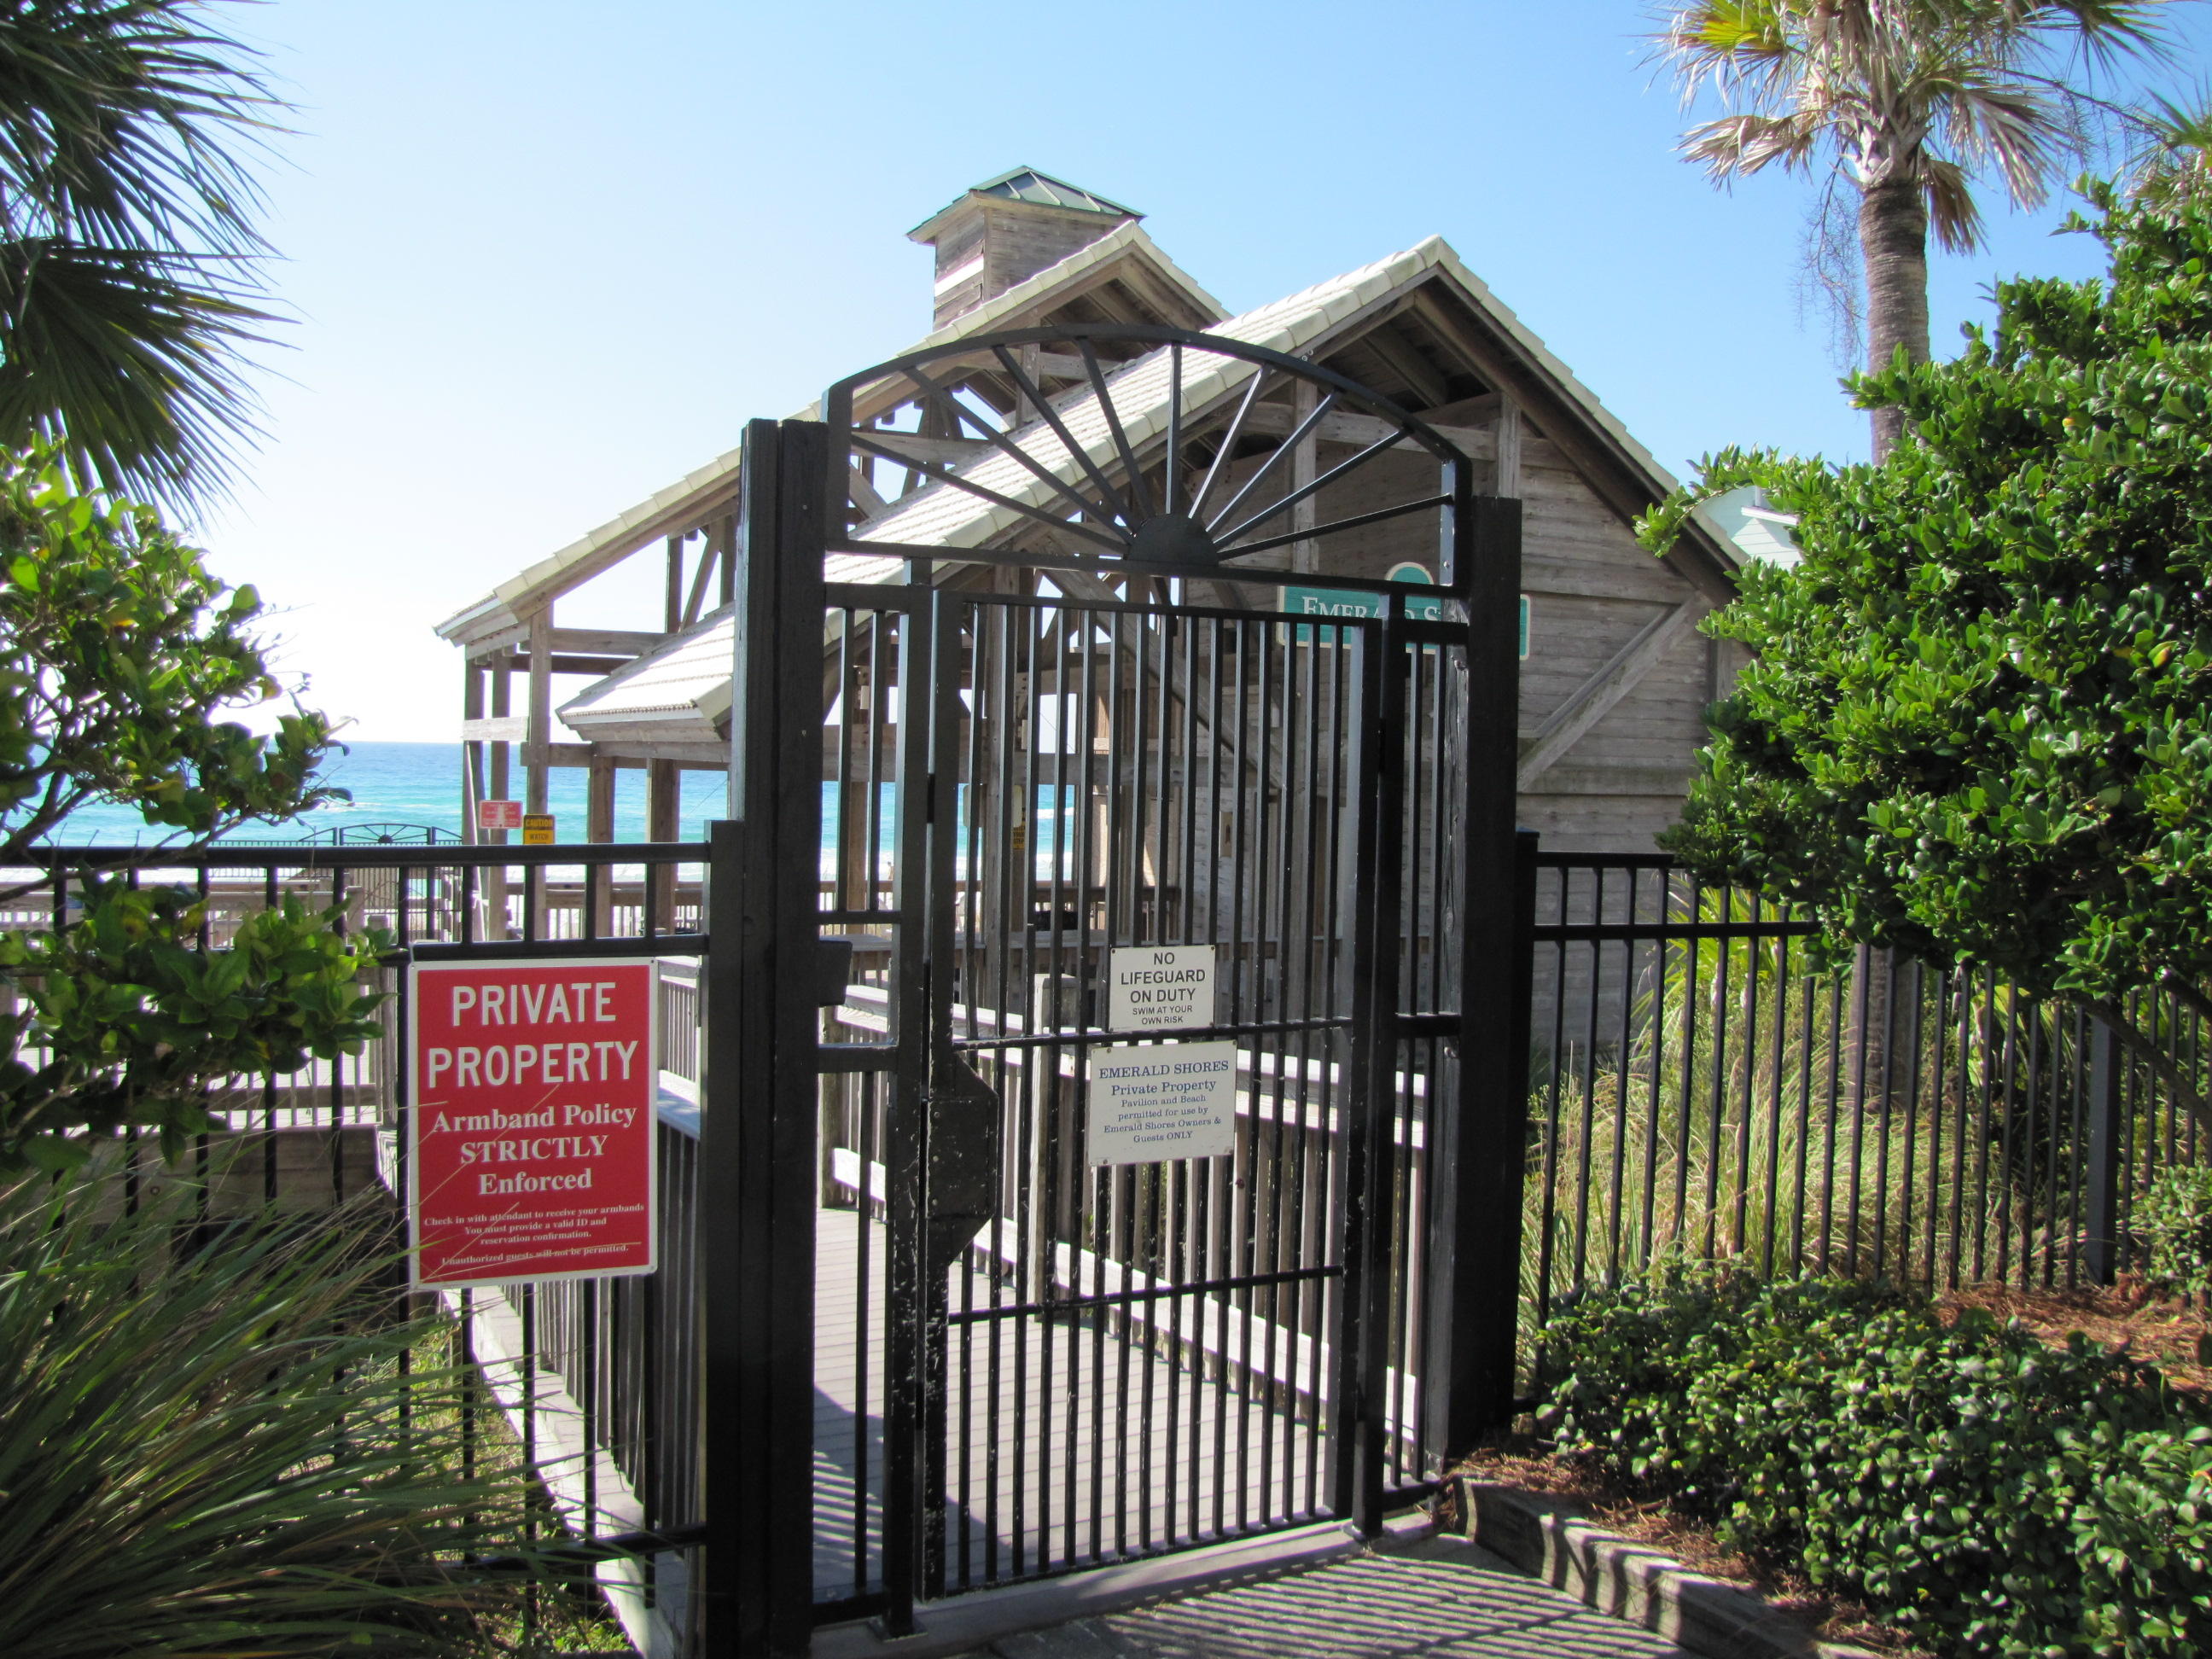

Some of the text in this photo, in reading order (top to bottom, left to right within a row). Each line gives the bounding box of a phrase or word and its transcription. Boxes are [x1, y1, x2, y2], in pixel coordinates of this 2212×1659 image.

[1154, 952, 1175, 965] NO
[1121, 969, 1206, 986] LIFEGUARD
[1130, 987, 1196, 1003] ON DUTY
[452, 981, 616, 1027] PRIVATE
[1132, 1004, 1192, 1016] SWIM AT YOUR
[1142, 1016, 1184, 1025] OWN RISK
[428, 1040, 639, 1089] PROPERTY
[1099, 1060, 1229, 1080] EMERALD SHORES
[1111, 1080, 1217, 1097] Private Property
[1121, 1094, 1206, 1108] Pavilion and Beach
[433, 1103, 637, 1133] Armband Policy
[1118, 1109, 1162, 1122] permitted
[1165, 1109, 1179, 1117] for
[1198, 1105, 1208, 1116] by
[1103, 1116, 1221, 1133] Emerald Shores Owners &
[1133, 1130, 1193, 1144] Guests ONLY
[460, 1134, 608, 1165] STRICTLY
[479, 1167, 593, 1195] Enforced
[424, 1216, 453, 1226] Check
[456, 1215, 464, 1224] in
[467, 1214, 487, 1223] with
[489, 1211, 533, 1222] attendant
[546, 1208, 577, 1218] receive
[579, 1207, 599, 1217] your
[600, 1202, 645, 1214] armbands
[464, 1226, 482, 1235] You
[483, 1225, 507, 1234] must
[509, 1221, 543, 1233] provide
[553, 1219, 574, 1229] valid
[577, 1218, 588, 1226] ID
[590, 1216, 608, 1226] and
[480, 1229, 592, 1245] reservation confirmation.
[441, 1252, 504, 1266] Unauthorized
[505, 1251, 533, 1263] guests
[553, 1249, 569, 1257] not
[570, 1247, 581, 1255] be
[584, 1243, 629, 1257] permitted.
